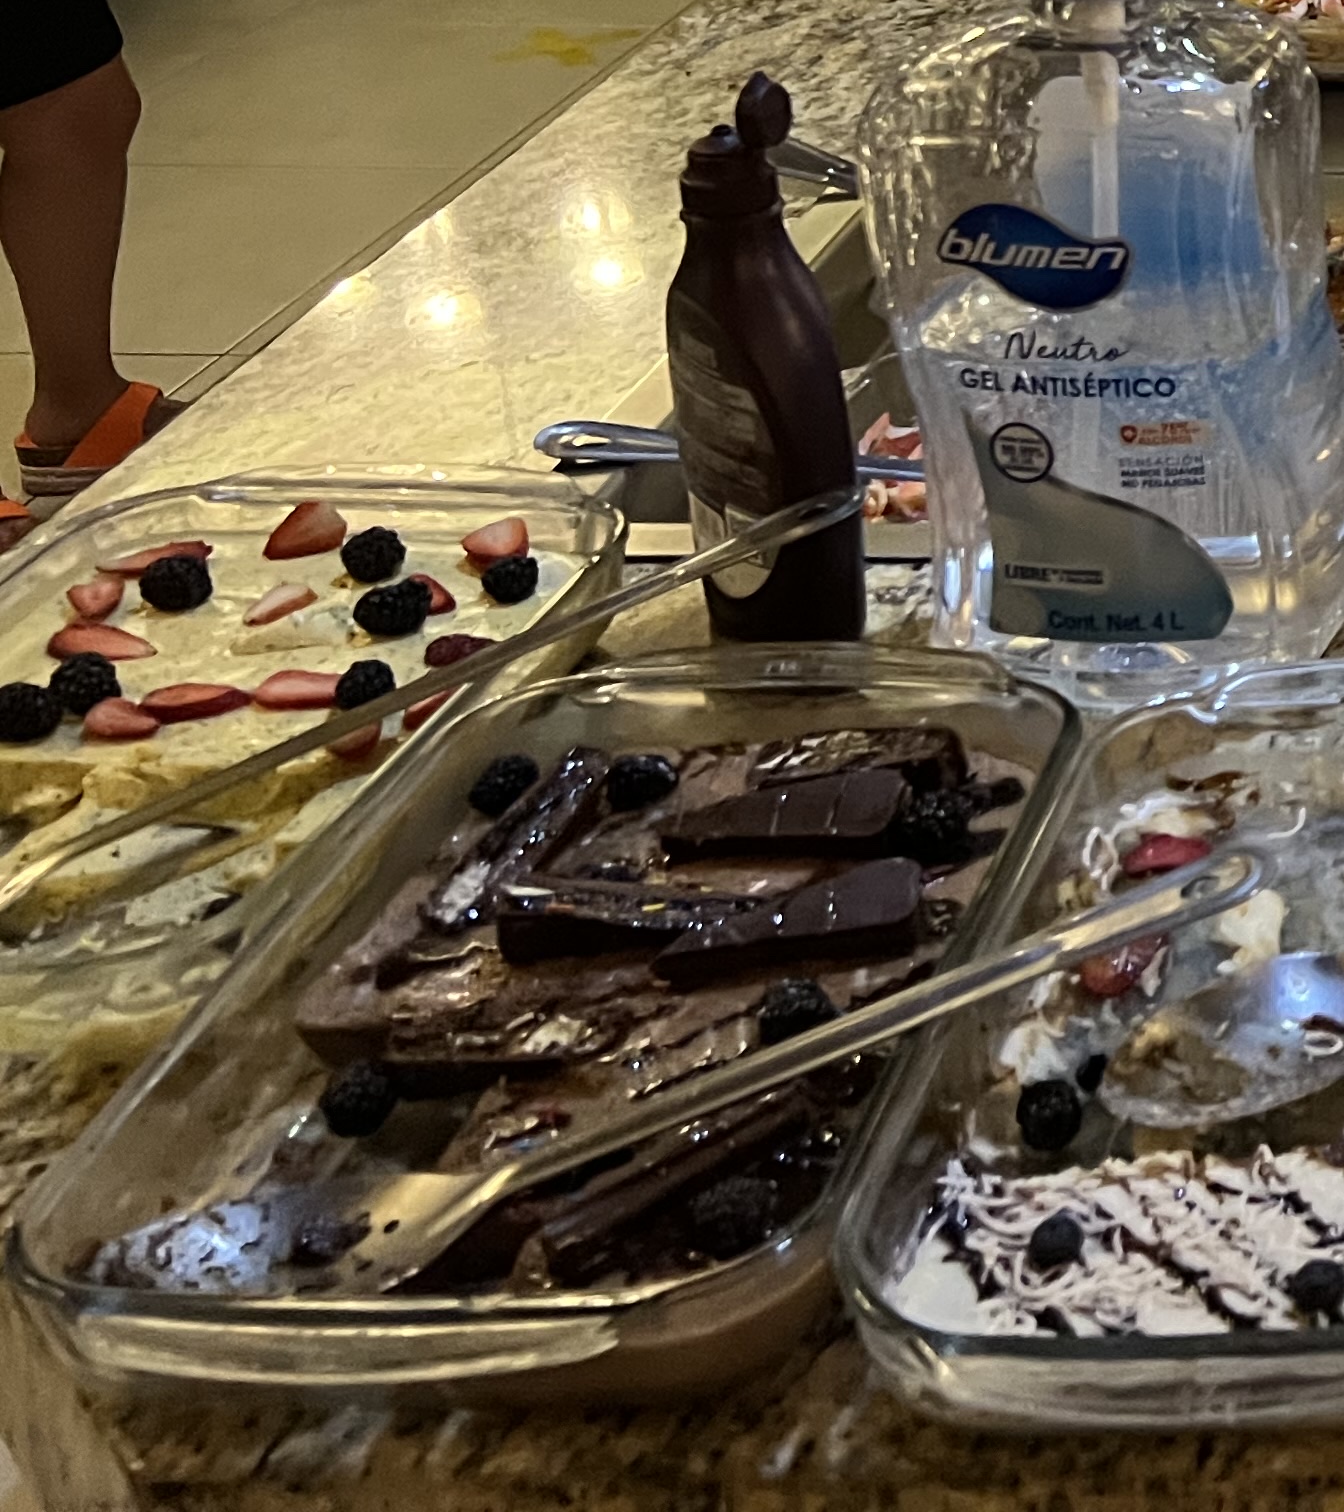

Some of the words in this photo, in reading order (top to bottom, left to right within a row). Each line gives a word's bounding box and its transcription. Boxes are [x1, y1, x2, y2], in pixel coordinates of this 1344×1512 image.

[940, 229, 1125, 271] blumen
[1004, 330, 1130, 362] Neutro
[960, 368, 1004, 392] GEL
[1011, 372, 1176, 398] ANTISÉPTICO
[1151, 612, 1165, 631] 4
[1171, 611, 1184, 631] L
